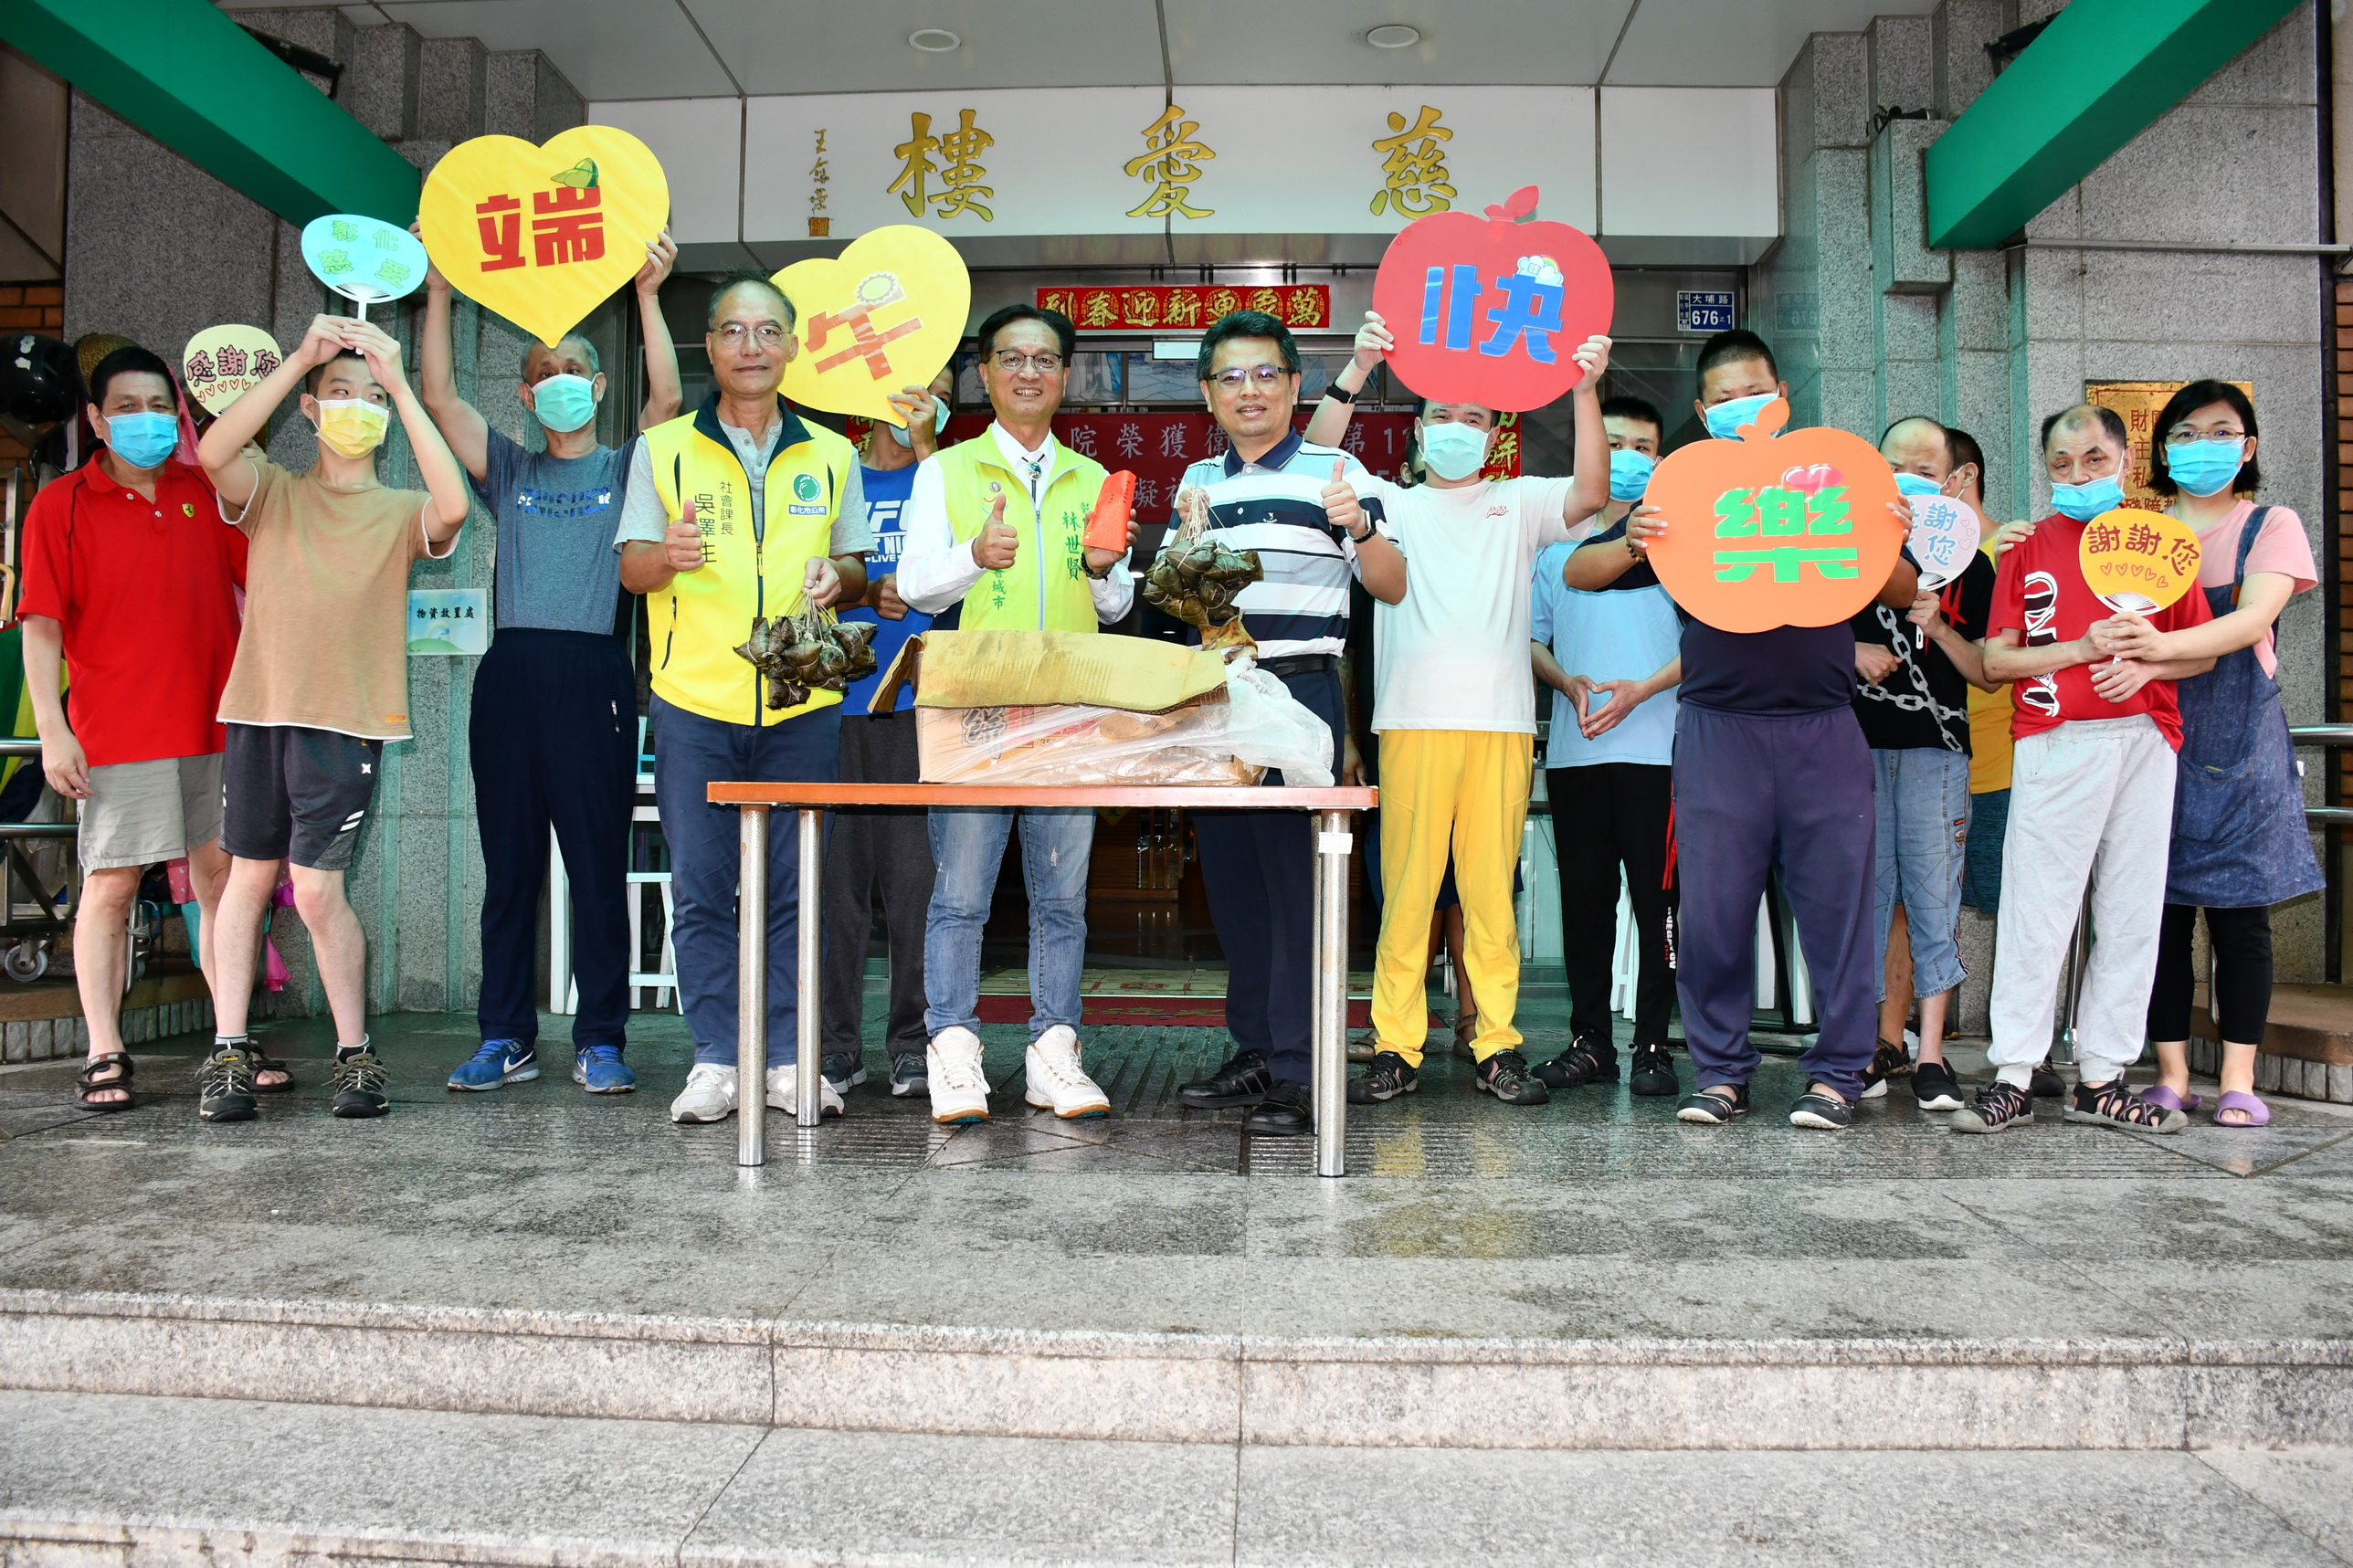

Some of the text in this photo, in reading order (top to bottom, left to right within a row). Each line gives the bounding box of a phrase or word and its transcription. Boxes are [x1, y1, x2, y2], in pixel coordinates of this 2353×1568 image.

[475, 184, 606, 273] 端
[1419, 263, 1567, 365] 快
[1692, 293, 1729, 305] 大埔路
[720, 480, 734, 536] 社會課長
[1713, 486, 1860, 584] 樂
[1062, 510, 1082, 582] 林世賢
[2086, 522, 2201, 577] 謝謝您
[416, 605, 475, 620] 物資放置處
